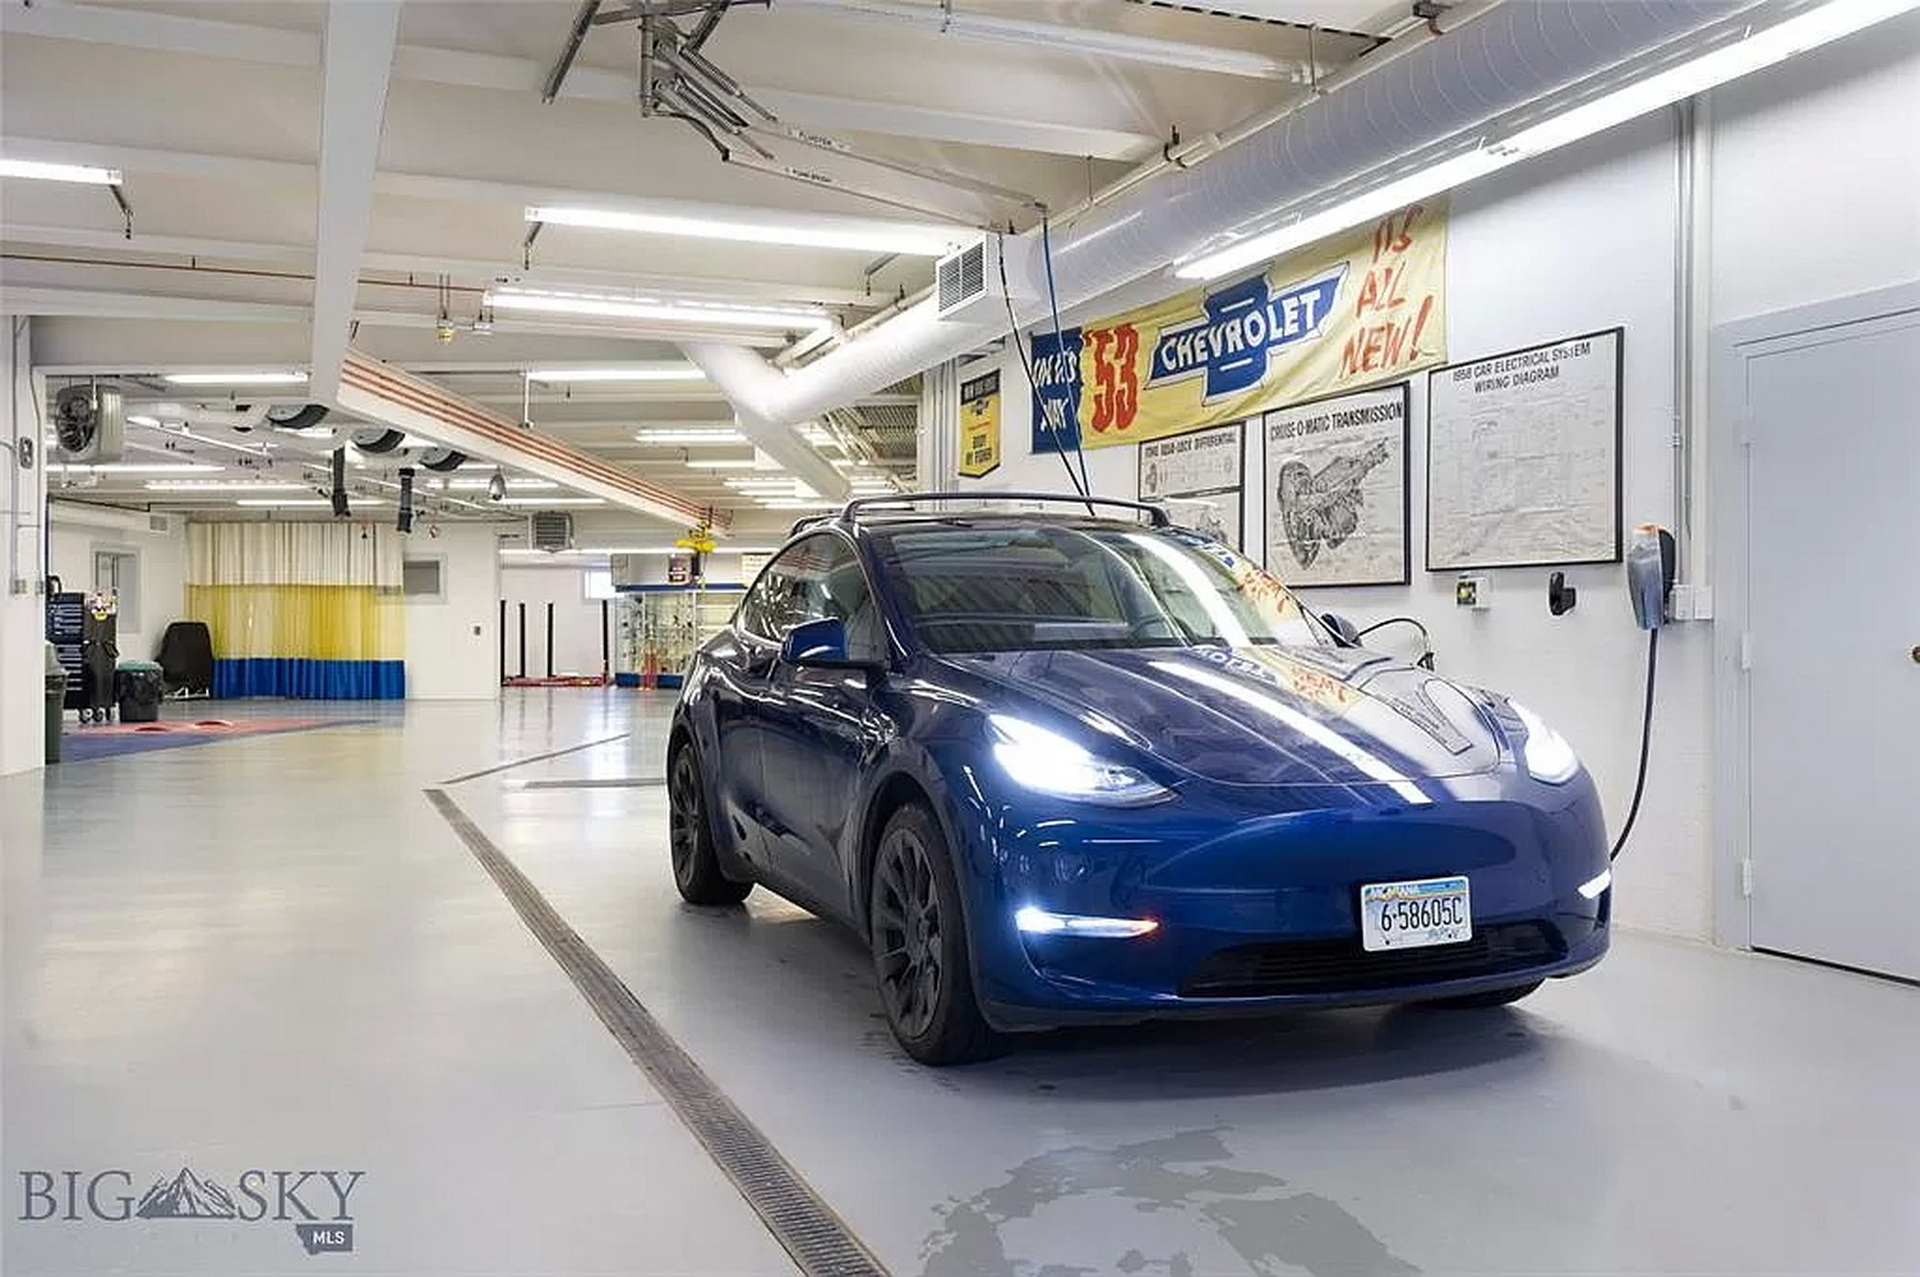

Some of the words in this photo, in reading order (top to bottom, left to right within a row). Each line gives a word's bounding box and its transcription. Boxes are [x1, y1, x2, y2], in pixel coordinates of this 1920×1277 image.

[1356, 261, 1406, 319] ALL
[1161, 289, 1321, 371] CHEVROLET
[1338, 294, 1434, 380] NEW!
[1082, 325, 1138, 433] '53
[1474, 364, 1493, 378] CAR
[1494, 351, 1550, 374] ELECTRICAL
[1552, 342, 1591, 360] SYSTEM
[1474, 375, 1512, 393] WIRING
[1513, 365, 1560, 386] DIAGRAM
[1332, 402, 1402, 430] TRANSMISSION
